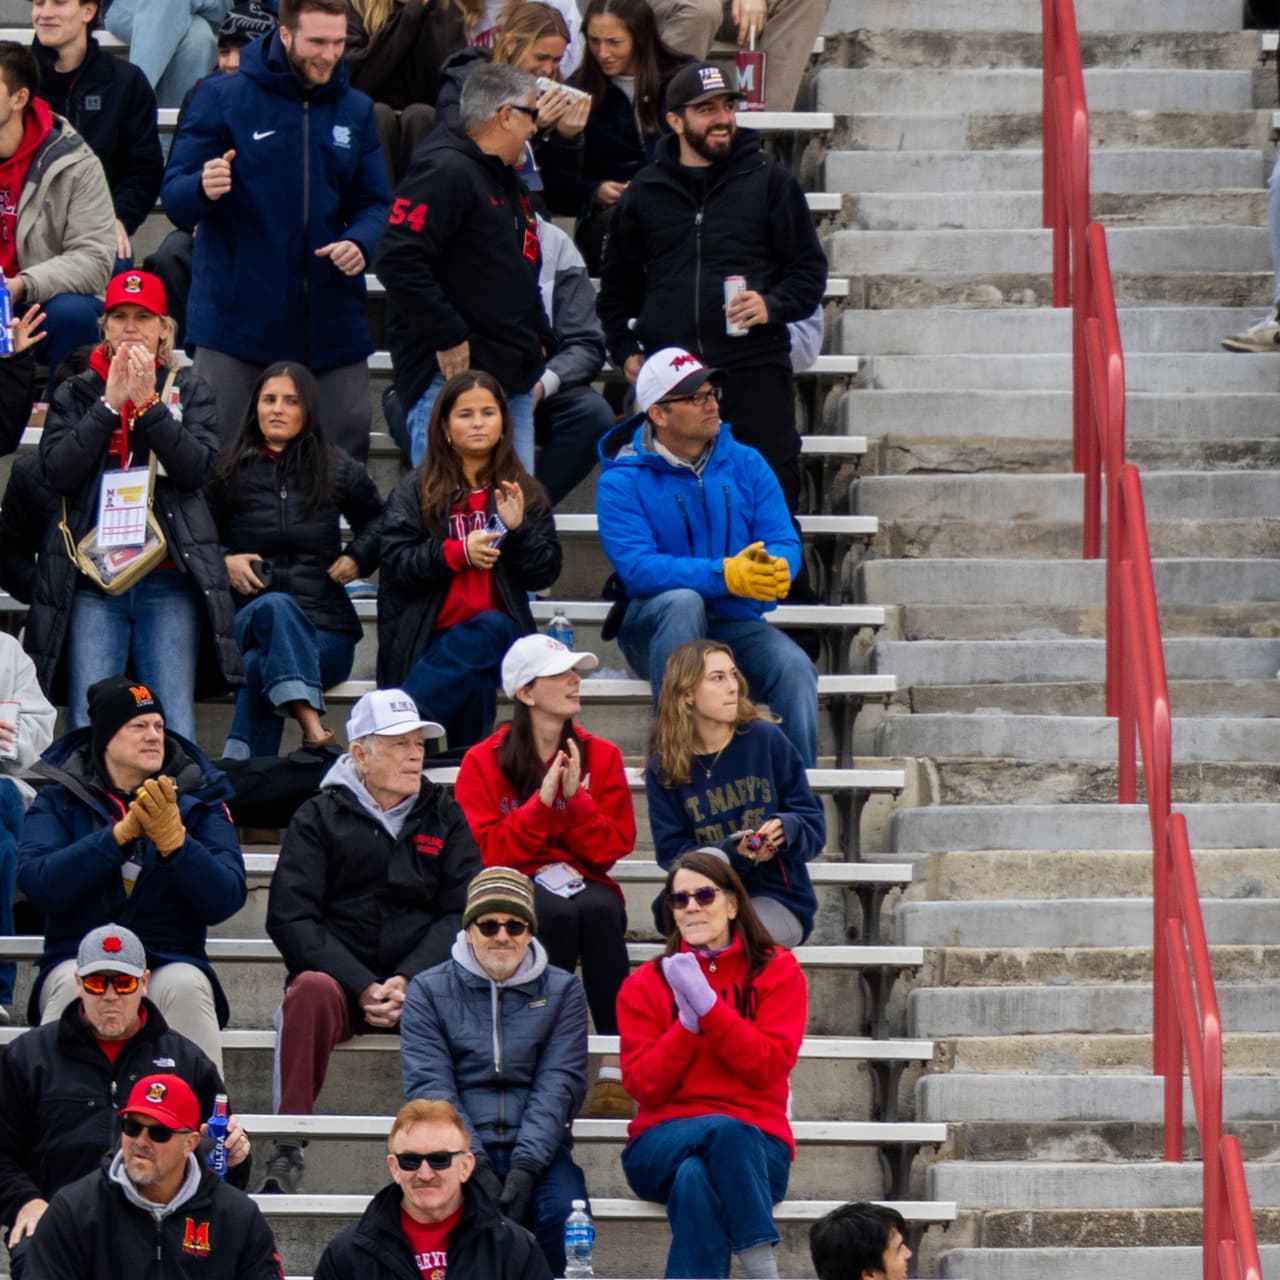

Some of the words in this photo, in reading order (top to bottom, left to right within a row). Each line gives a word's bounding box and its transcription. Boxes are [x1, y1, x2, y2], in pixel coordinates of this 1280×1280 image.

[389, 198, 428, 232] 54
[213, 1134, 226, 1171] ULTRA
[183, 1216, 211, 1251] M
